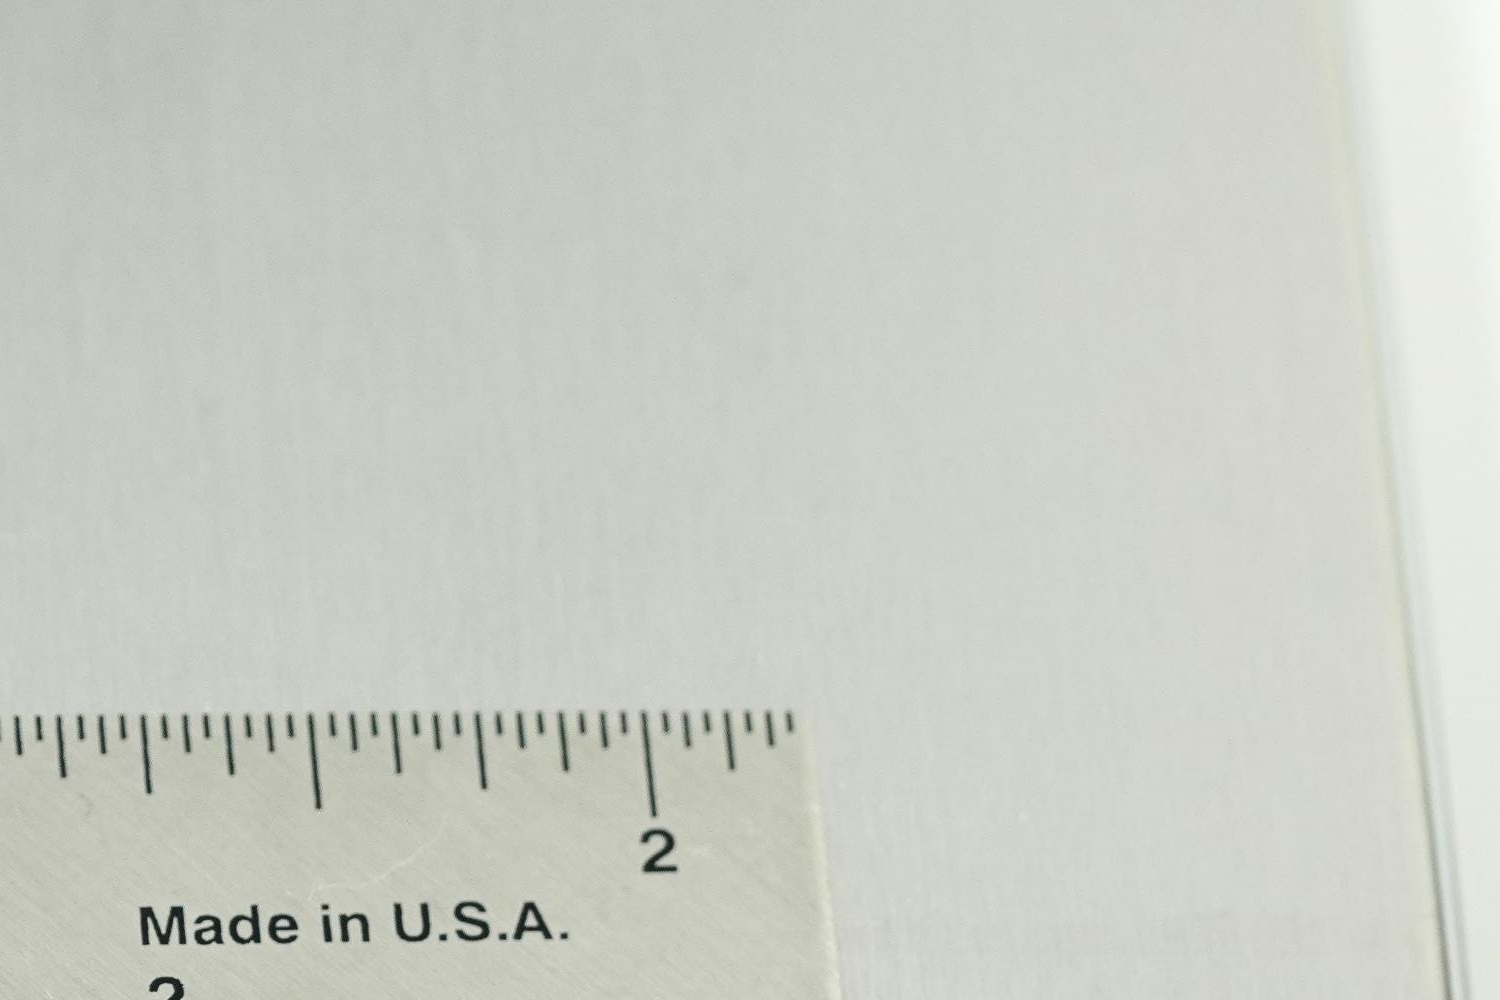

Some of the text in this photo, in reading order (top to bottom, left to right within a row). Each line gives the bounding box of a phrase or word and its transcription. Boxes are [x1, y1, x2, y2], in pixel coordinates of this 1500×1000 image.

[641, 828, 679, 873] 2
[138, 900, 572, 947] Made in U.S.A.
